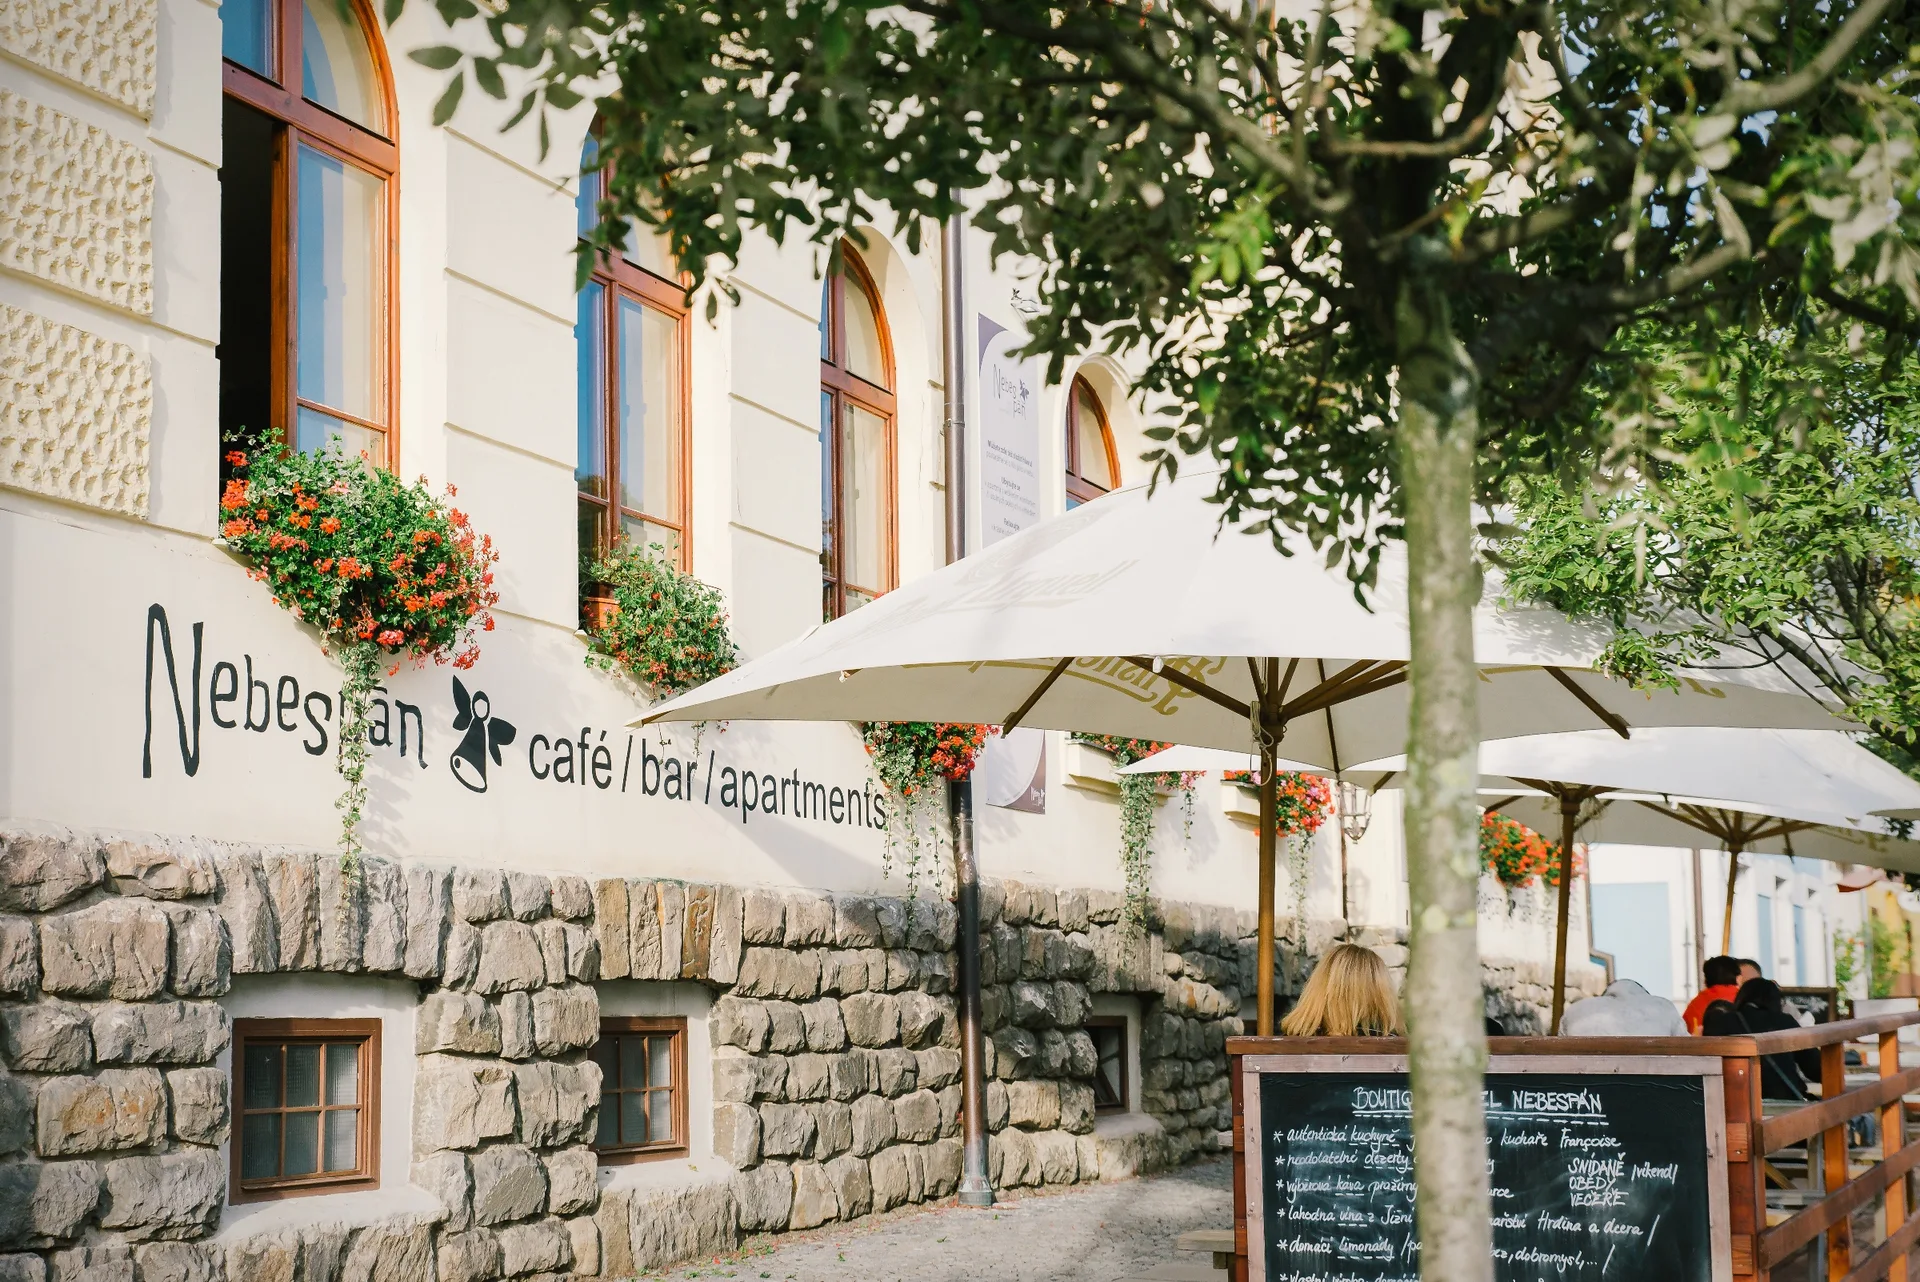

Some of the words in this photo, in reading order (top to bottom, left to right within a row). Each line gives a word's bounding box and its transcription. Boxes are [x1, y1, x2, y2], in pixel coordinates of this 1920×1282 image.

[529, 726, 612, 790] café
[642, 738, 696, 801] bar
[720, 766, 886, 829] apartments
[1352, 1086, 1413, 1110] BOUTIQ
[1512, 1088, 1602, 1113] NEBESPÁN
[1287, 1124, 1347, 1142] autentická
[1350, 1125, 1400, 1151] kuchyně
[1500, 1128, 1548, 1146] kuchaře
[1560, 1127, 1622, 1151] Françoise
[1365, 1150, 1409, 1172] dezerty
[1568, 1152, 1626, 1177] SNÍDANĚ
[1336, 1175, 1364, 1191] káva
[1288, 1204, 1336, 1222] lahodná
[1537, 1209, 1582, 1232] Hrdina
[1588, 1223, 1600, 1233] a
[1604, 1218, 1644, 1236] dcera
[1289, 1234, 1333, 1254] domácí
[1339, 1236, 1394, 1262] limonády
